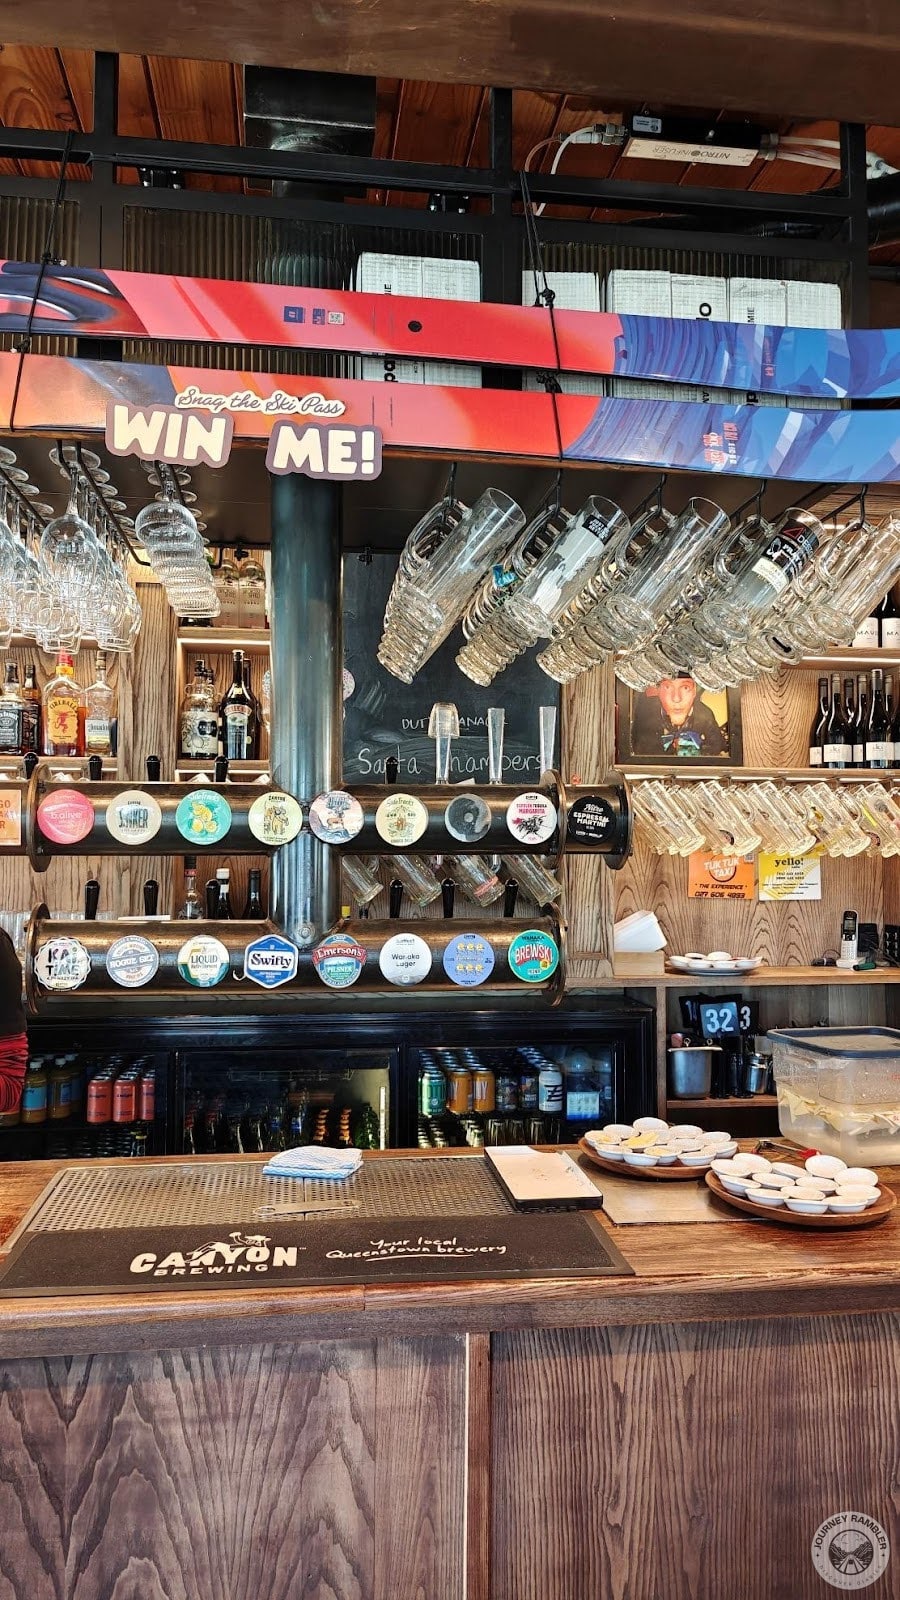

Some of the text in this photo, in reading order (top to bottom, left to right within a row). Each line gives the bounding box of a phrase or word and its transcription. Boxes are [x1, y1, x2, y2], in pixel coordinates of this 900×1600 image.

[178, 388, 342, 414] Snag the Ski Pass
[113, 404, 375, 475] WIN ME!
[576, 818, 607, 828] MARTINI
[703, 856, 740, 870] TUK TUK
[774, 857, 804, 868] yello!
[714, 867, 733, 877] TAXI
[191, 954, 218, 964] LIQUID
[317, 945, 362, 959] Emerson's
[515, 943, 553, 965] BREWSKI
[250, 952, 292, 969] Swifty
[705, 1008, 734, 1033] 32
[370, 1236, 458, 1250] Your local
[325, 1244, 508, 1259] Queenstown brewery
[129, 1246, 298, 1274] CANYON
[153, 1264, 269, 1277] BREWING
